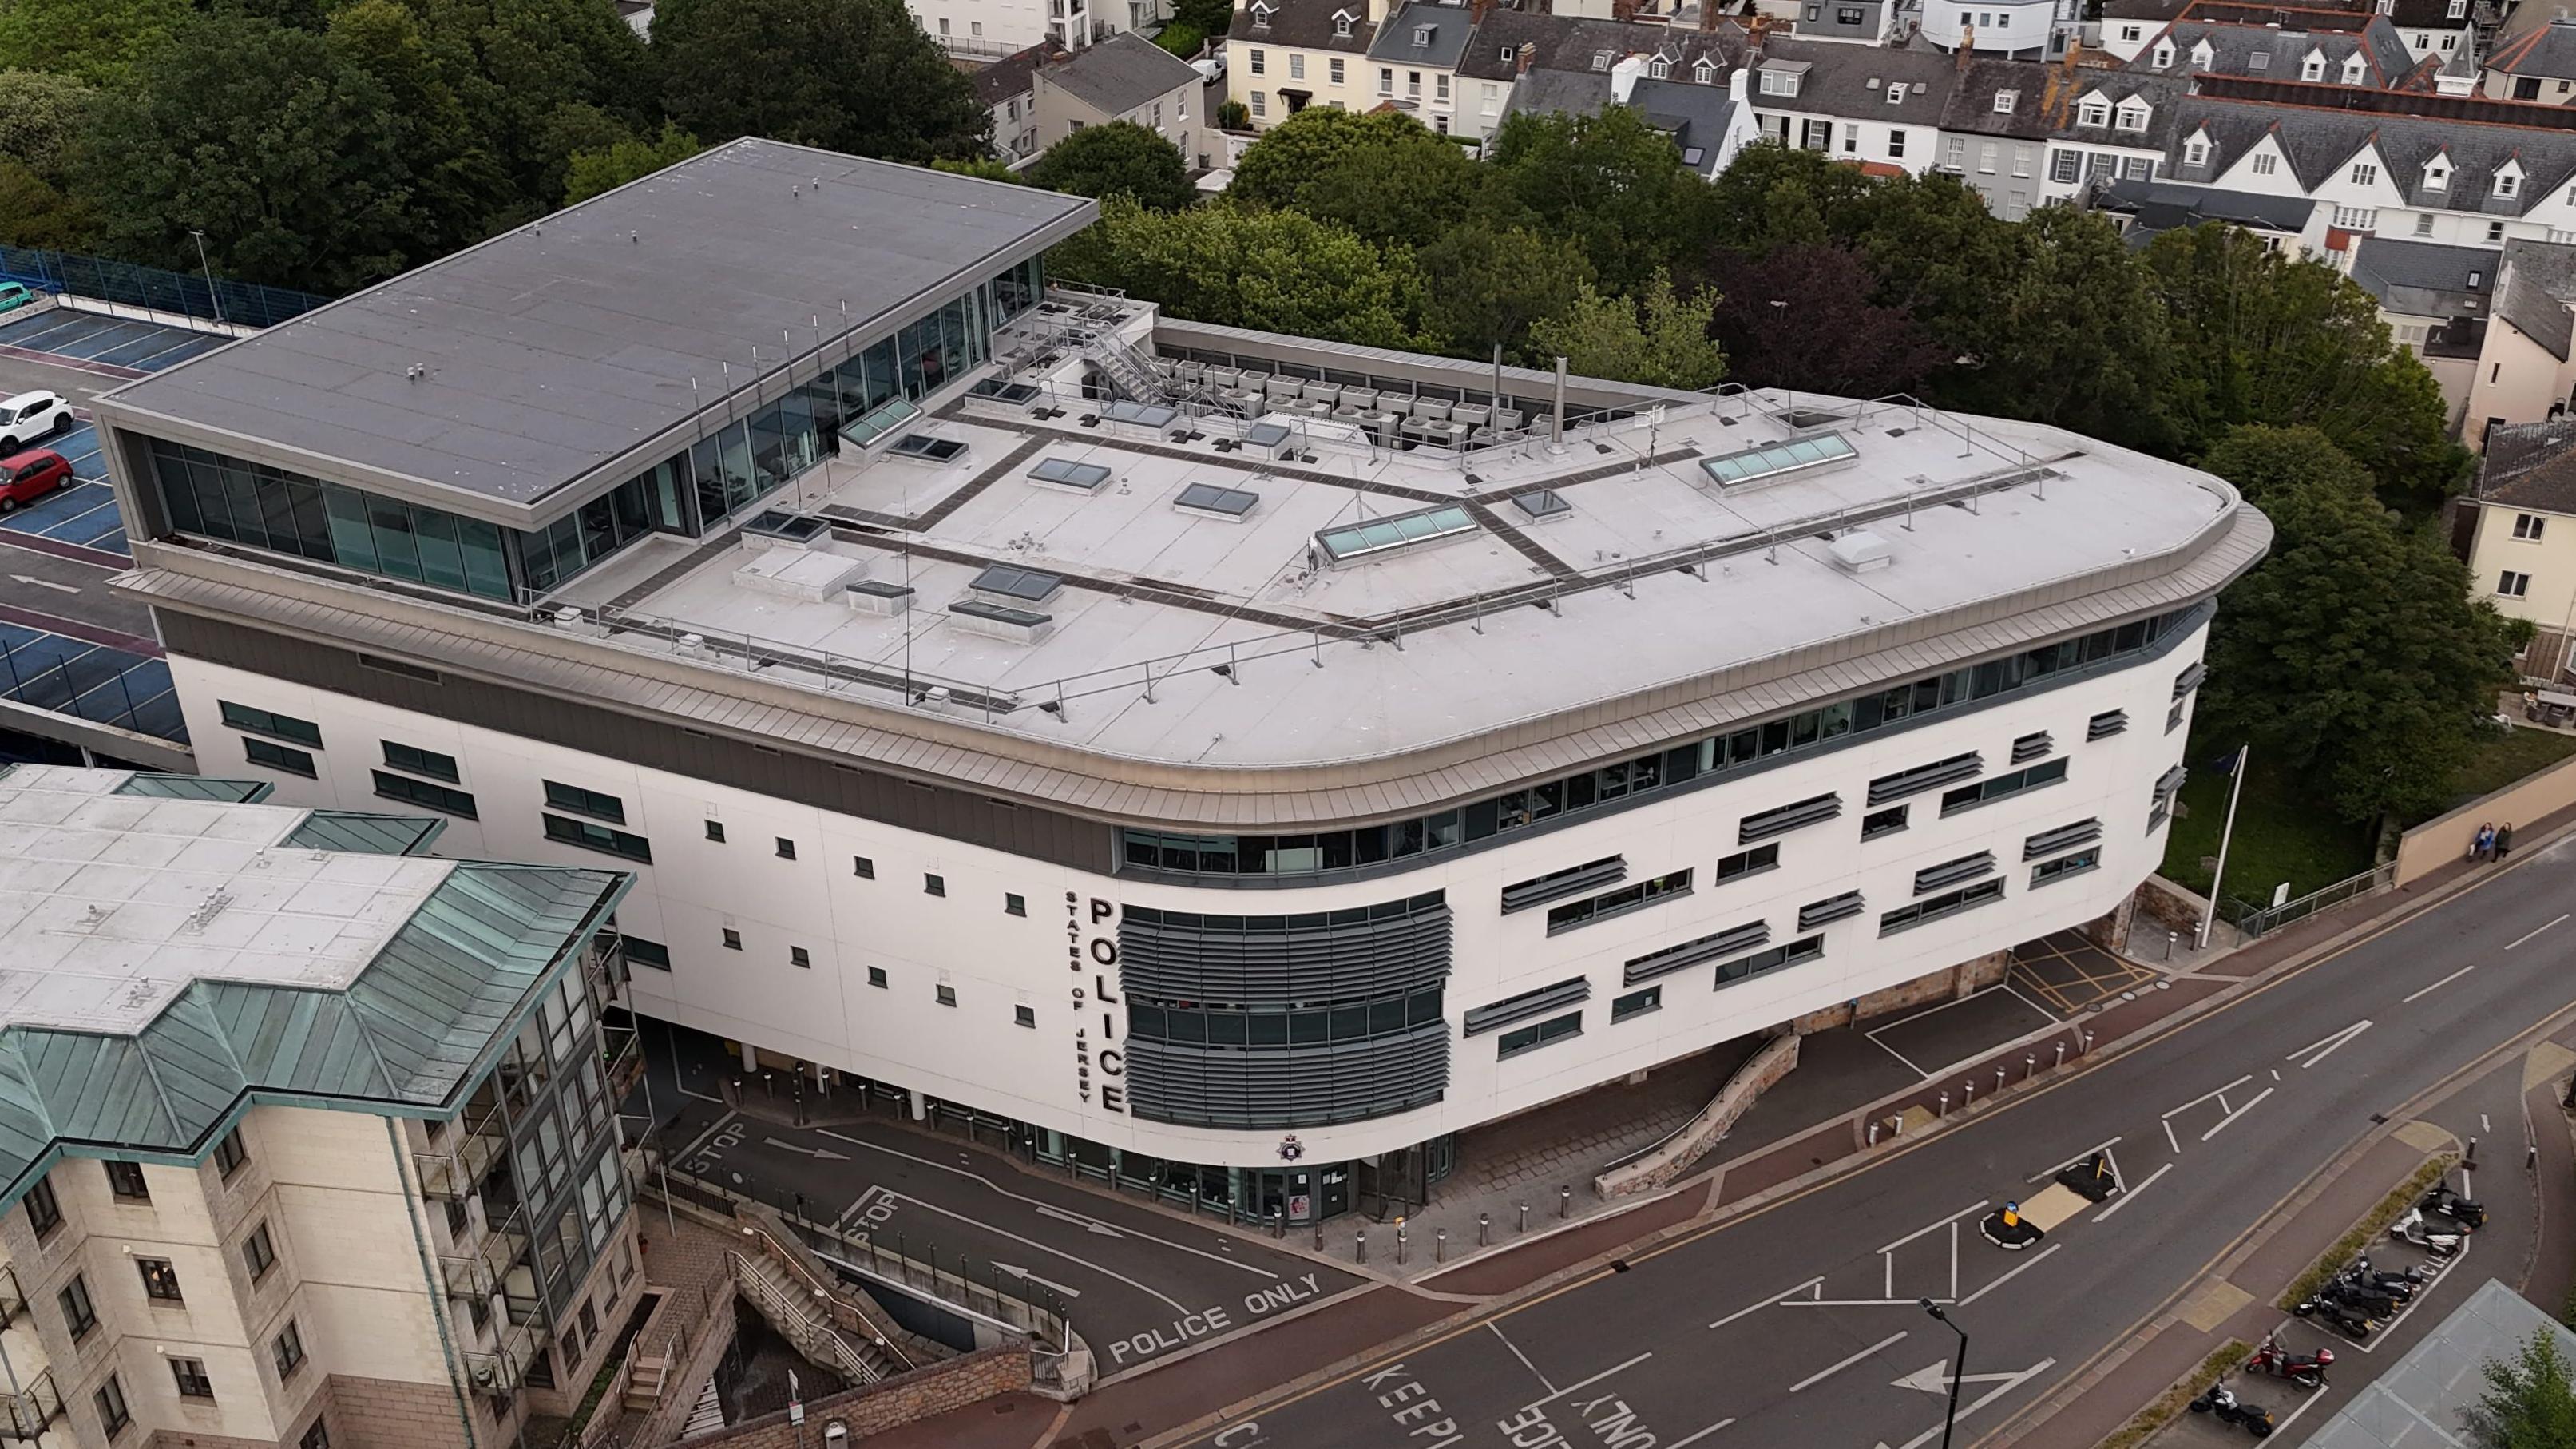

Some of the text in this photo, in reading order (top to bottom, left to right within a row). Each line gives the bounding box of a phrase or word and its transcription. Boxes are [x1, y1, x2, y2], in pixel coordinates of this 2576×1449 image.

[1065, 891, 1091, 1103] STATES OF JERSEY
[1090, 897, 1124, 1114] POLICE
[685, 1122, 747, 1174] STOP
[843, 1193, 899, 1242] STOP
[1108, 1272, 1320, 1364] POLICE ONLY
[1361, 1363, 1458, 1438] KEEP
